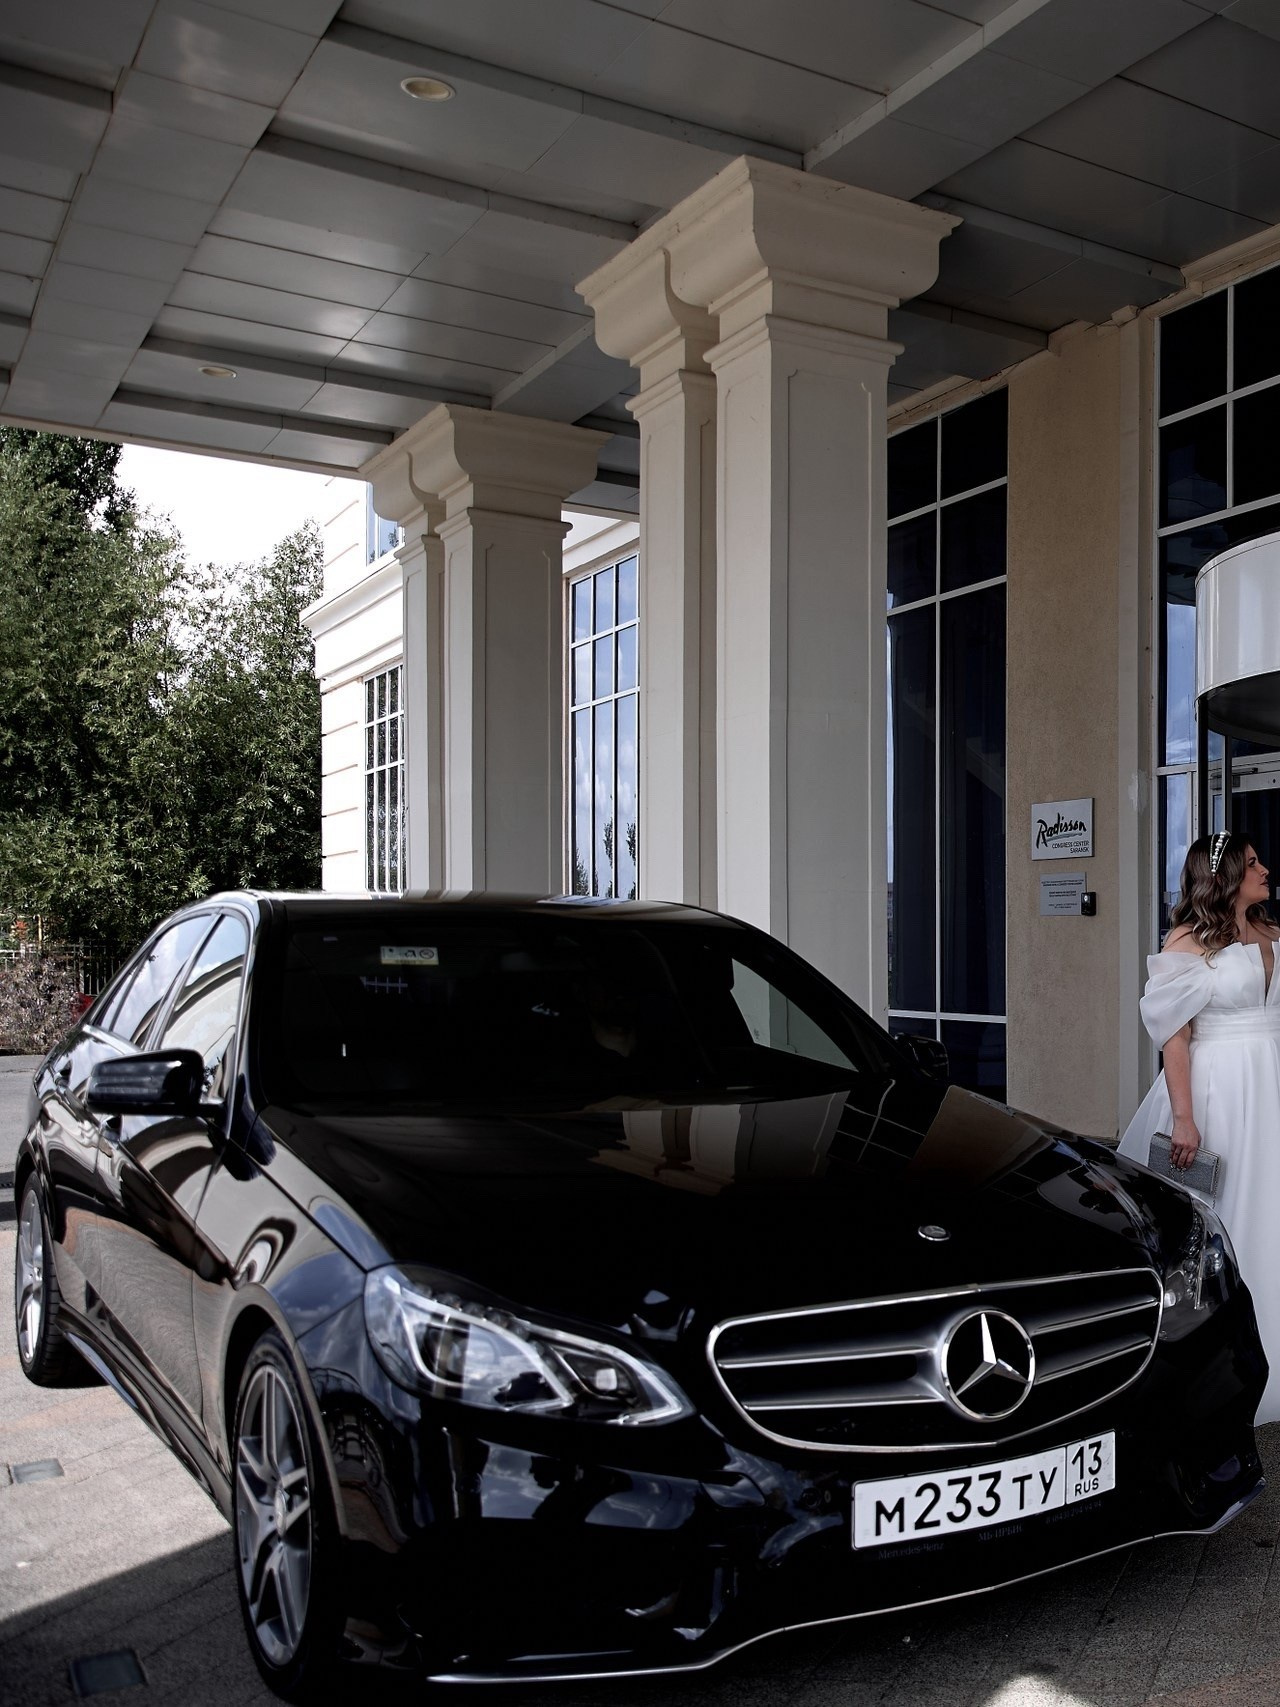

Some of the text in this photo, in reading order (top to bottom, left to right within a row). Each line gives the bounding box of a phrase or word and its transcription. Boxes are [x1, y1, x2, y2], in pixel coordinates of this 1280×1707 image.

[1036, 812, 1087, 849] Radisson
[1071, 1440, 1103, 1480] 13
[1074, 1478, 1100, 1497] RUS
